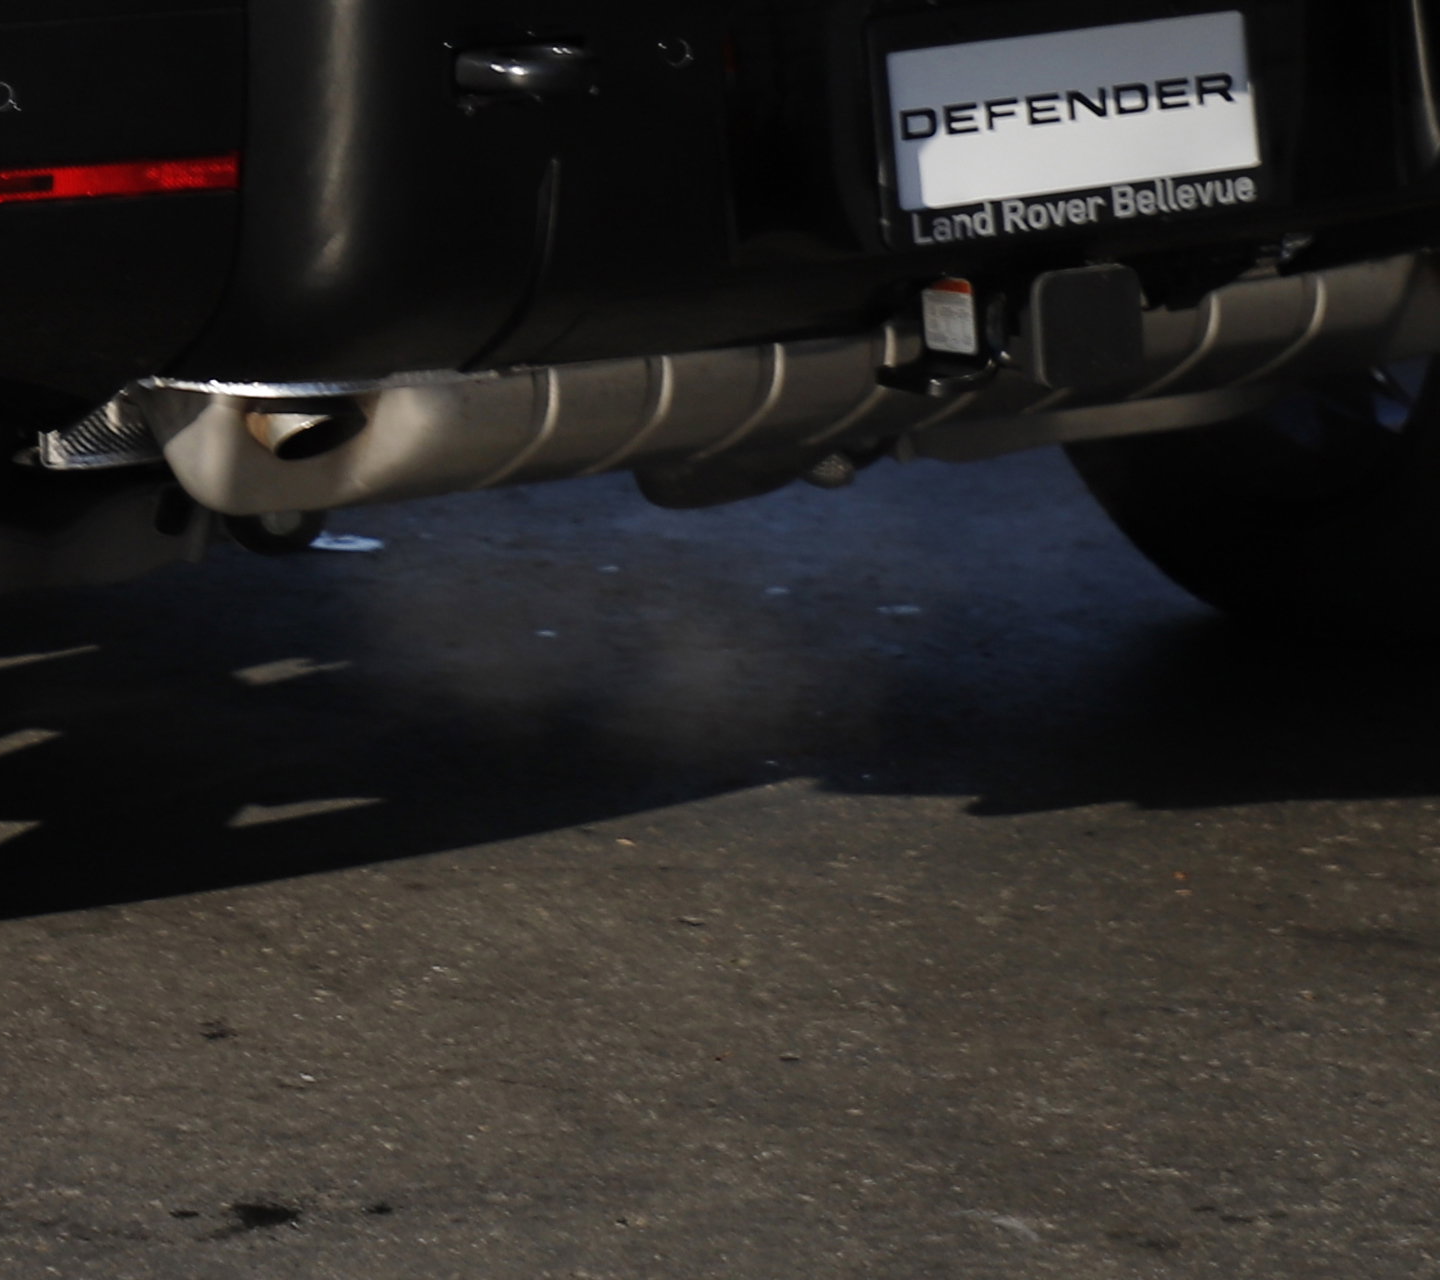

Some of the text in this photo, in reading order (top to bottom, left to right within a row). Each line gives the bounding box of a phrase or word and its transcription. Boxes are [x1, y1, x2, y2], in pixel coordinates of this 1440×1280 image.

[900, 72, 1235, 140] DEFENDER
[913, 175, 1257, 244] Land Rover Bellevue
